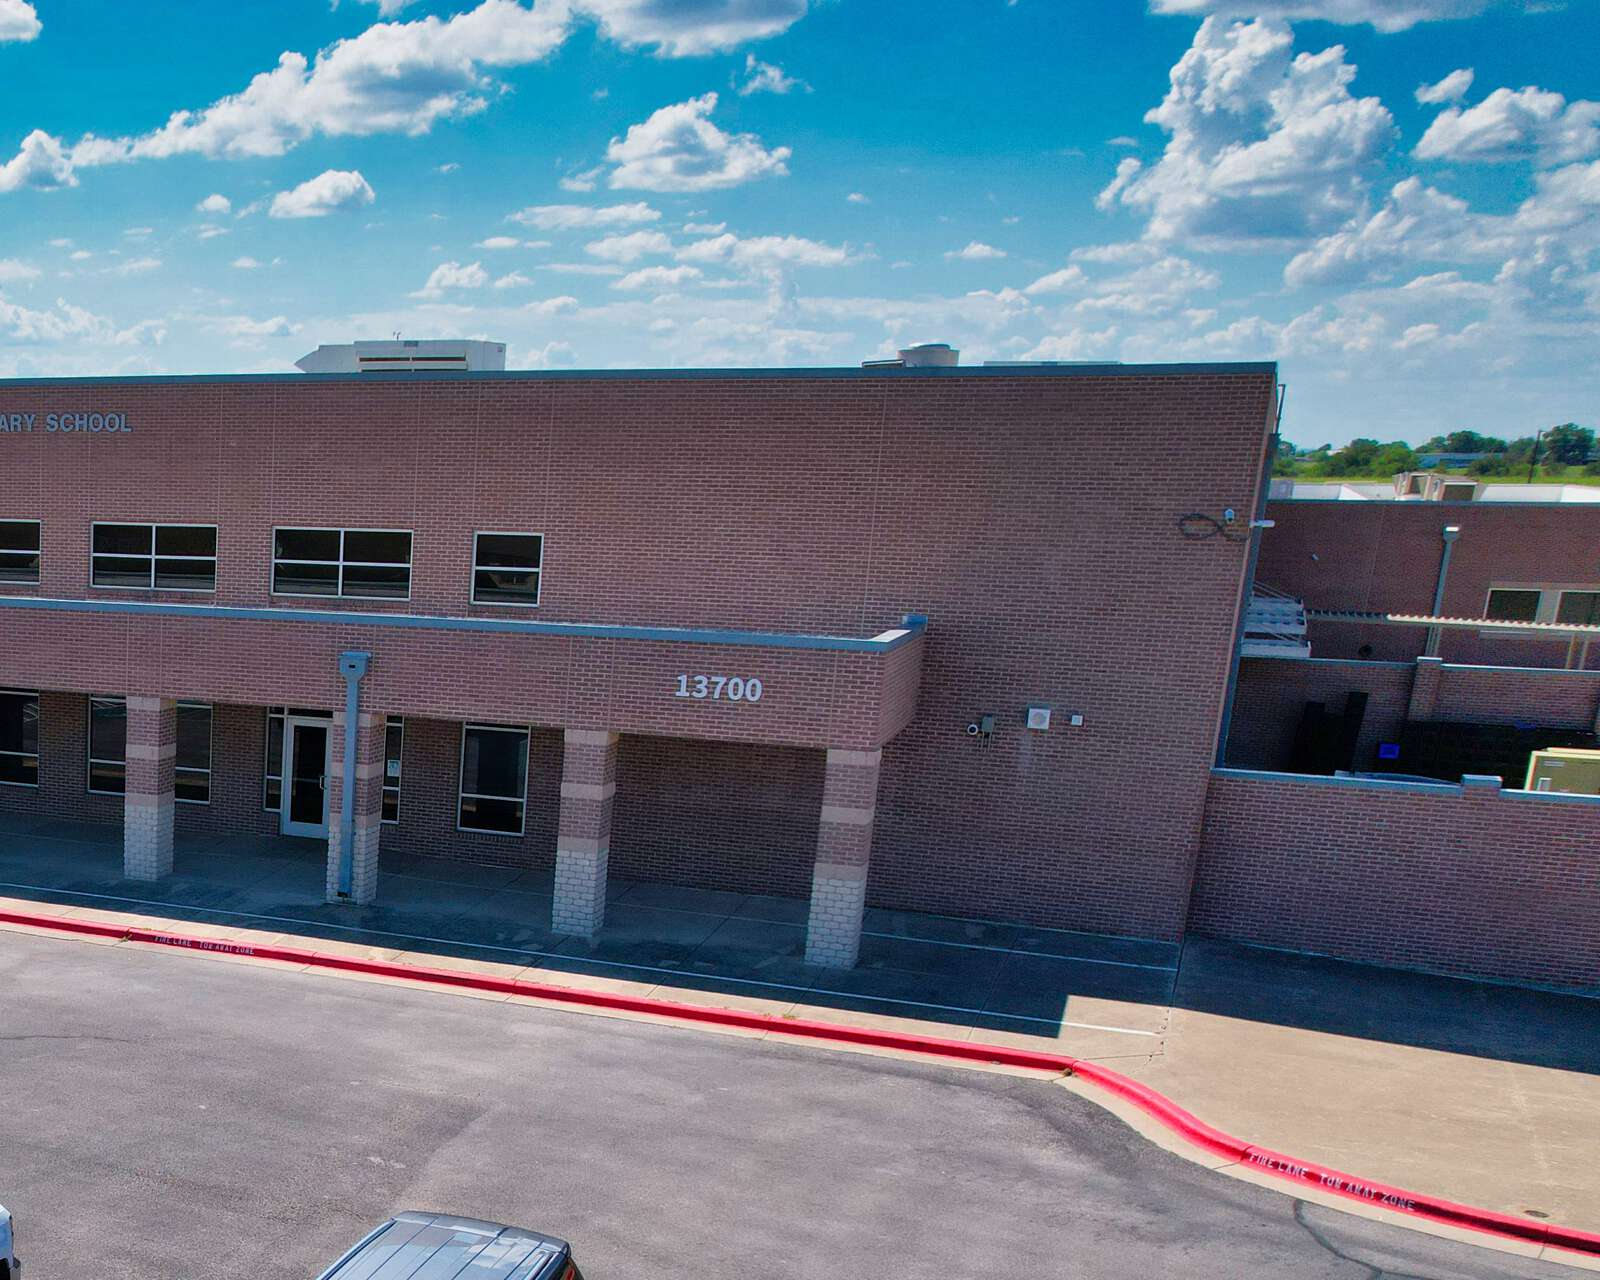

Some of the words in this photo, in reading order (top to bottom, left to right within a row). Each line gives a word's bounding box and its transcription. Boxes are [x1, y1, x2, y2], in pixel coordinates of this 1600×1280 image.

[46, 413, 132, 432] SCHOOL
[675, 674, 762, 701] 13700
[154, 935, 171, 944] FIRE
[173, 938, 192, 947] LANE
[200, 941, 215, 949] TOW
[236, 946, 255, 955] ZONE
[1249, 1153, 1273, 1168] FIRE
[1278, 1160, 1309, 1179] LANE
[1320, 1173, 1343, 1190] TOW
[1346, 1182, 1377, 1201] AWAY
[1383, 1192, 1416, 1211] ZONE
